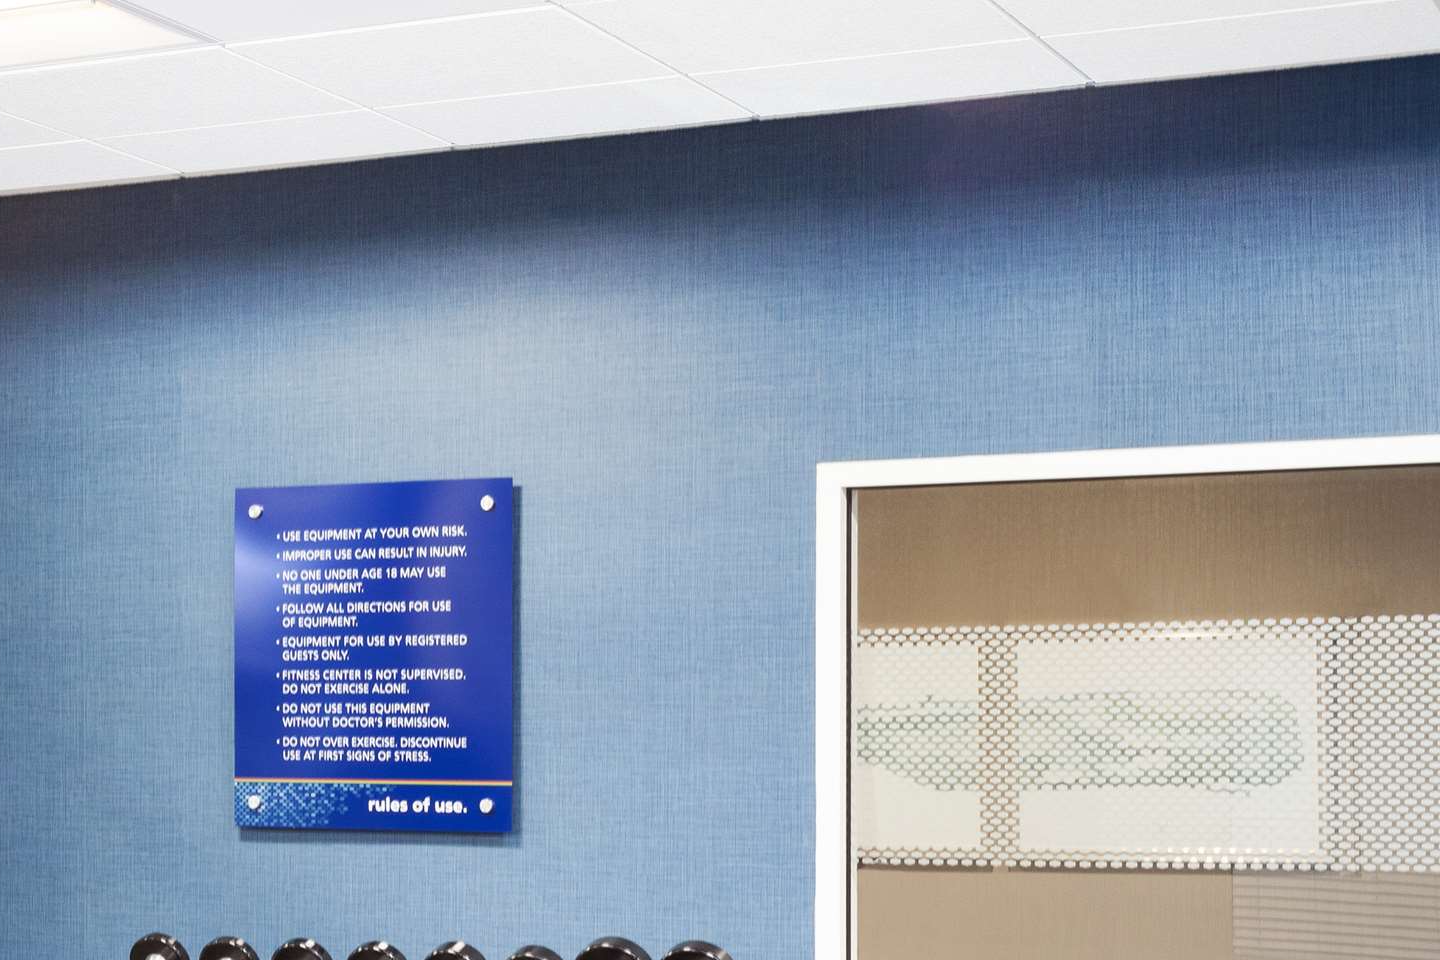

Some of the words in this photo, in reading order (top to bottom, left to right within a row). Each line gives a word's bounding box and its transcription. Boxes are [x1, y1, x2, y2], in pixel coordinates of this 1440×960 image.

[283, 530, 301, 542] USE
[304, 529, 361, 542] EQUIPMENT
[364, 528, 378, 539] AT
[380, 527, 409, 539] YOUR
[412, 526, 439, 538] OWN
[442, 525, 467, 537] RISK.
[283, 550, 331, 561] IMPROPER
[334, 549, 352, 560] USE
[355, 548, 376, 559] CAN
[378, 548, 413, 559] RESULT
[416, 547, 427, 558] IN
[429, 546, 467, 557] INJURY.
[283, 570, 298, 581] NO
[300, 569, 321, 581] ONE
[324, 568, 359, 580] UNDER
[361, 568, 382, 579] AGE
[386, 568, 397, 579] 18
[400, 567, 424, 578] MAY
[427, 566, 446, 578] USE
[283, 583, 301, 594] THE
[304, 582, 364, 595] EQUIPMENT.
[283, 603, 324, 614] FOLLOW
[326, 603, 344, 613] ALL
[347, 602, 406, 613] DIRECTIONS
[409, 601, 429, 612] FOR
[432, 601, 451, 612] USE
[283, 617, 295, 628] OF
[298, 616, 358, 629] EQUIPMENT.
[283, 637, 341, 649] EQUIPMENT
[344, 636, 364, 647] FOR
[367, 636, 385, 647] USE
[389, 635, 403, 646] BY
[405, 635, 467, 646] REGISTERED
[283, 650, 319, 661] GUESTS
[321, 650, 349, 661] ONLY.
[283, 670, 320, 681] FITNESS
[323, 669, 361, 680] CENTER
[364, 669, 372, 680] IS
[376, 669, 398, 680] NOT
[401, 668, 466, 680] SUPERVISED.
[283, 684, 298, 694] DO
[300, 683, 321, 694] NOT
[324, 683, 369, 694] EXERCISE
[372, 683, 409, 694] ALONE.
[283, 703, 298, 714] DO
[300, 703, 321, 714] NOT
[324, 703, 342, 714] USE
[345, 703, 367, 714] THIS
[370, 703, 430, 715] EQUIPMENT
[283, 717, 329, 728] WITHOUT
[332, 717, 383, 728] DOCTOR'S
[385, 717, 449, 728] PERMISSION.
[283, 737, 298, 747] DO
[300, 736, 321, 747] NOT
[323, 736, 349, 747] OVER
[351, 736, 398, 748] EXERCISE.
[401, 737, 467, 748] DISCONTINUE
[283, 750, 301, 761] USE
[303, 750, 316, 761] AT
[318, 750, 344, 761] FIRST
[346, 750, 375, 761] SIGNS
[378, 751, 392, 761] OF
[394, 751, 432, 762] STRESS.
[368, 797, 408, 812] rules
[412, 797, 431, 812] of
[435, 801, 467, 813] use.
